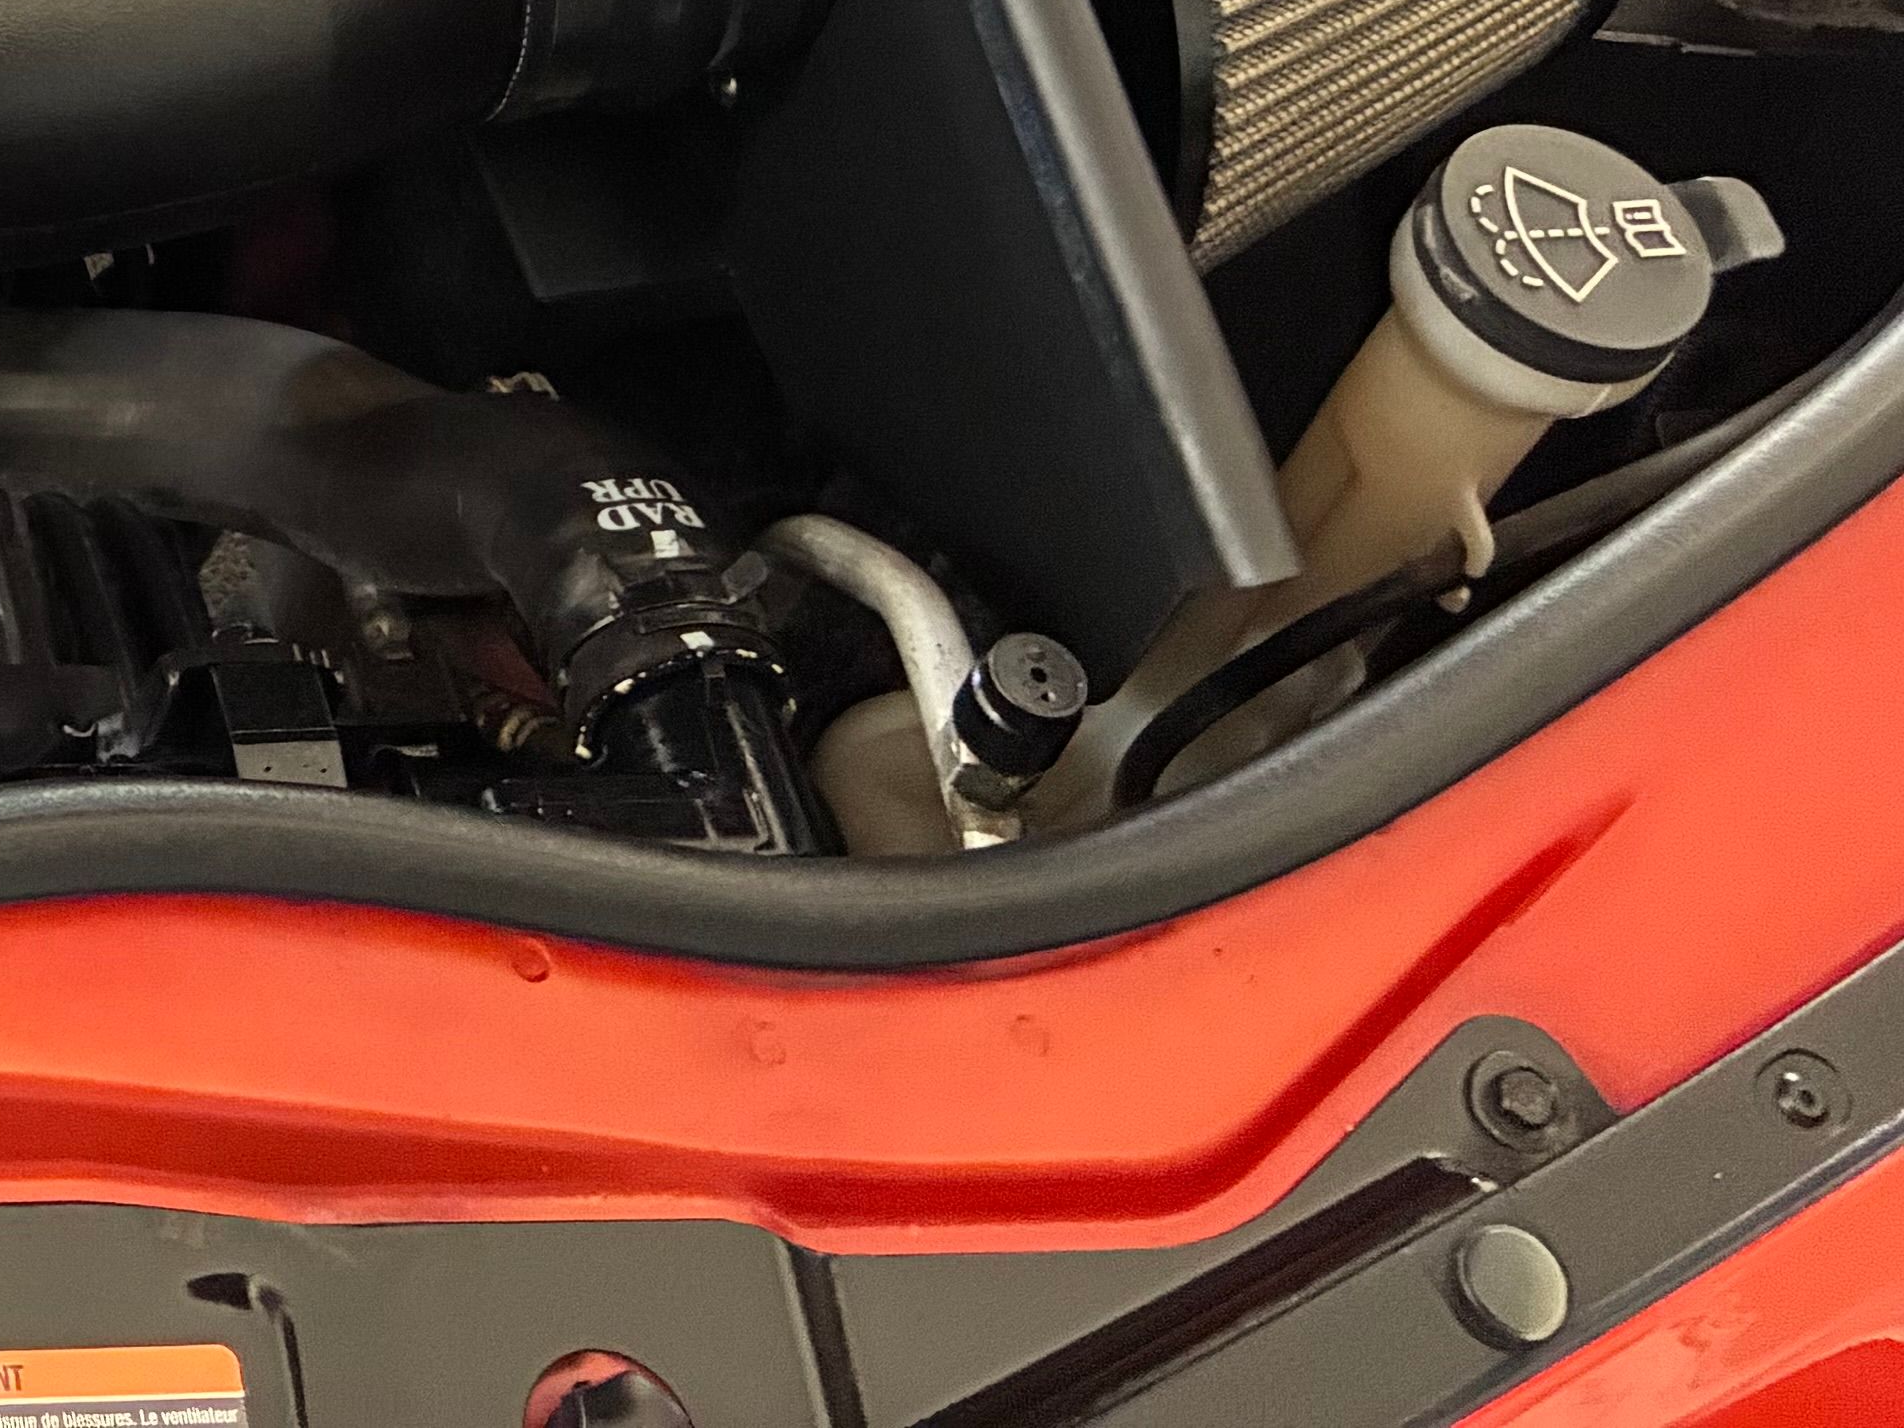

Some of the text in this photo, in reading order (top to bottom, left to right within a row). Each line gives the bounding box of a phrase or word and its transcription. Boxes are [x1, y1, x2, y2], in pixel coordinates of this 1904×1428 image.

[580, 477, 688, 503] UPR
[596, 502, 706, 531] RAD
[139, 1408, 159, 1426] Le
[161, 1406, 239, 1426] ventilateur
